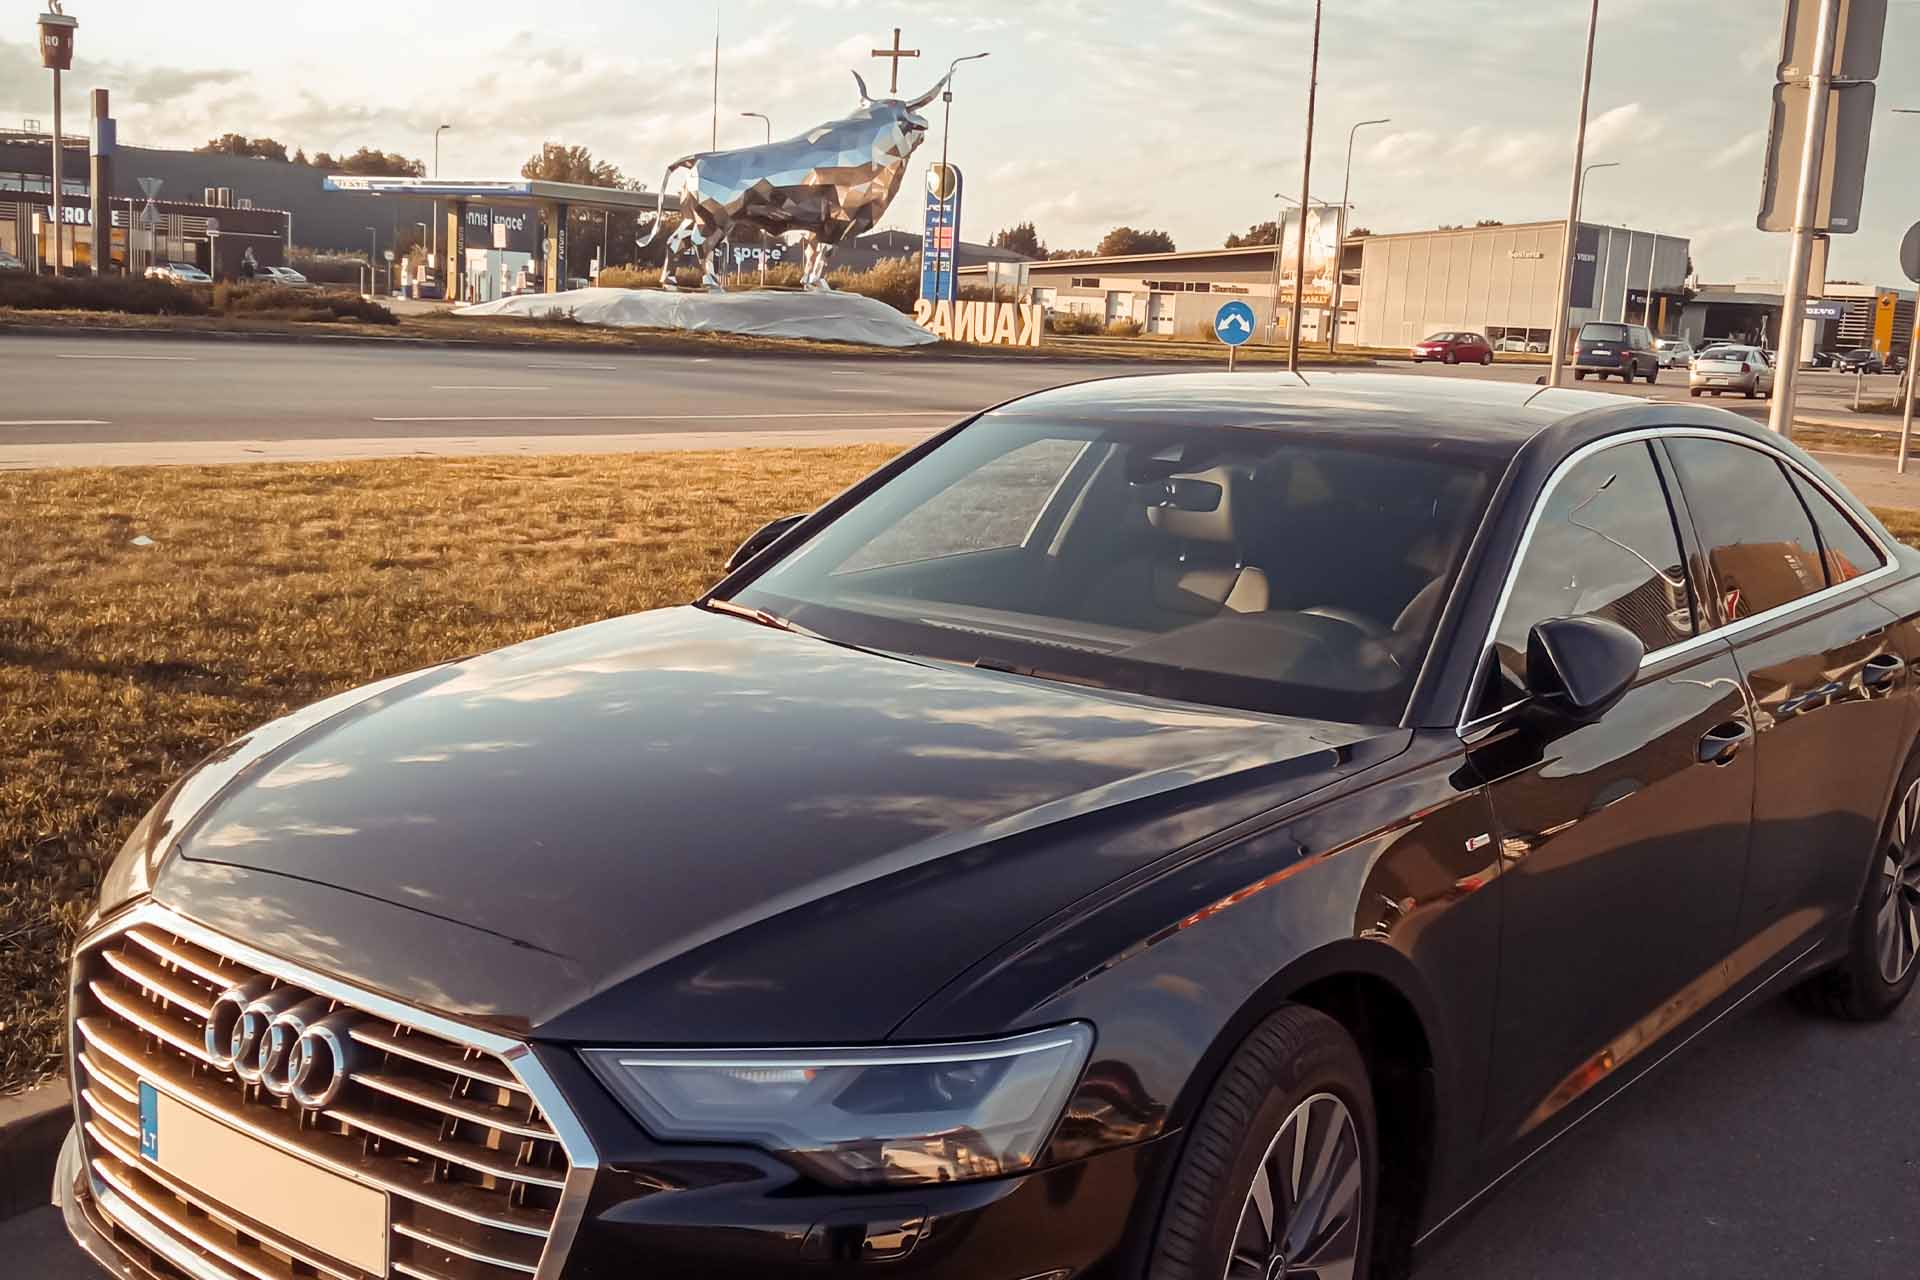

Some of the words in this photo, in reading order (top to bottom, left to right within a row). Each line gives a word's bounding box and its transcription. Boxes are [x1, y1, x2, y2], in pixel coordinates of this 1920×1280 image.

[466, 211, 488, 226] nnis
[1805, 307, 1836, 315] OLVO
[142, 1128, 156, 1151] LT
